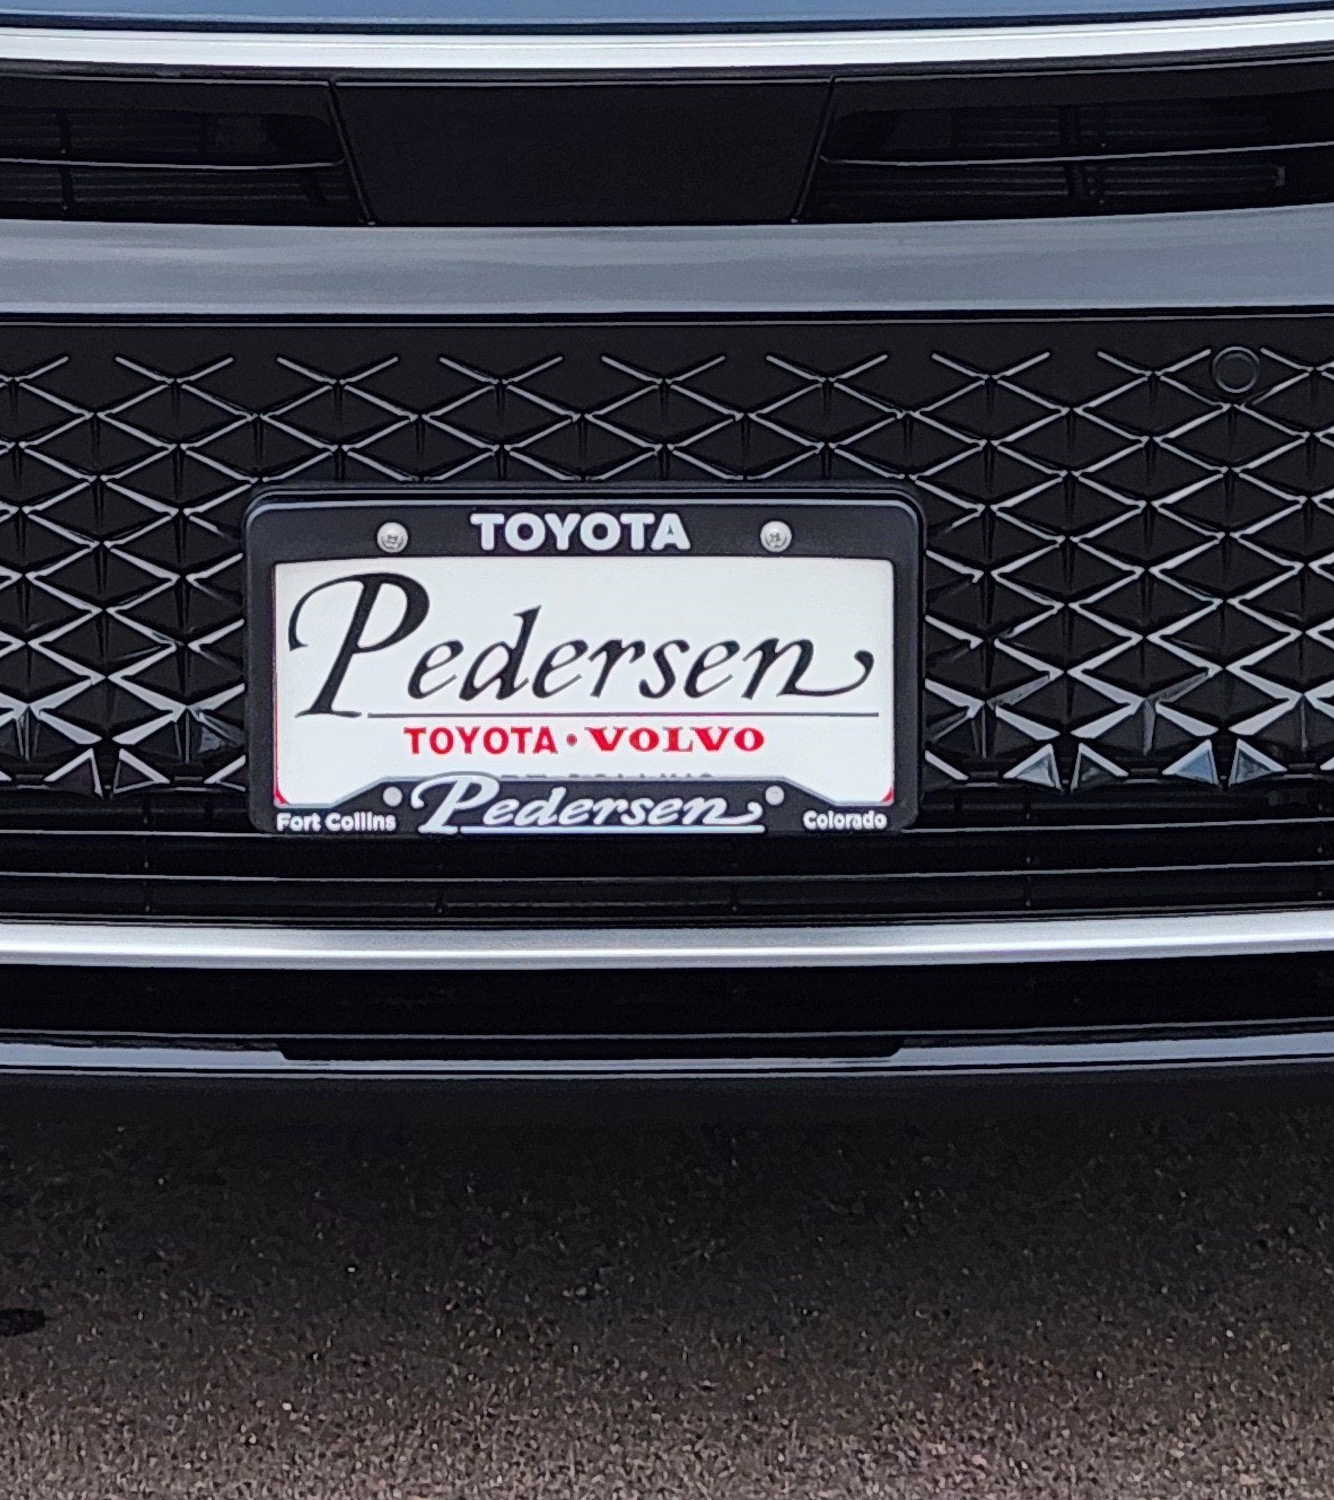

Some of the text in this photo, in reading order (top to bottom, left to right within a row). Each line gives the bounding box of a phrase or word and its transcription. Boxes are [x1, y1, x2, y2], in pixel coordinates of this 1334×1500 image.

[470, 512, 691, 551] TOYOTA
[288, 572, 875, 719] Pedersen
[403, 726, 765, 755] TOYOTA VOLVO
[410, 771, 766, 834] Pedersen
[276, 811, 397, 832] Fort Collins
[803, 810, 888, 831] Colorado
